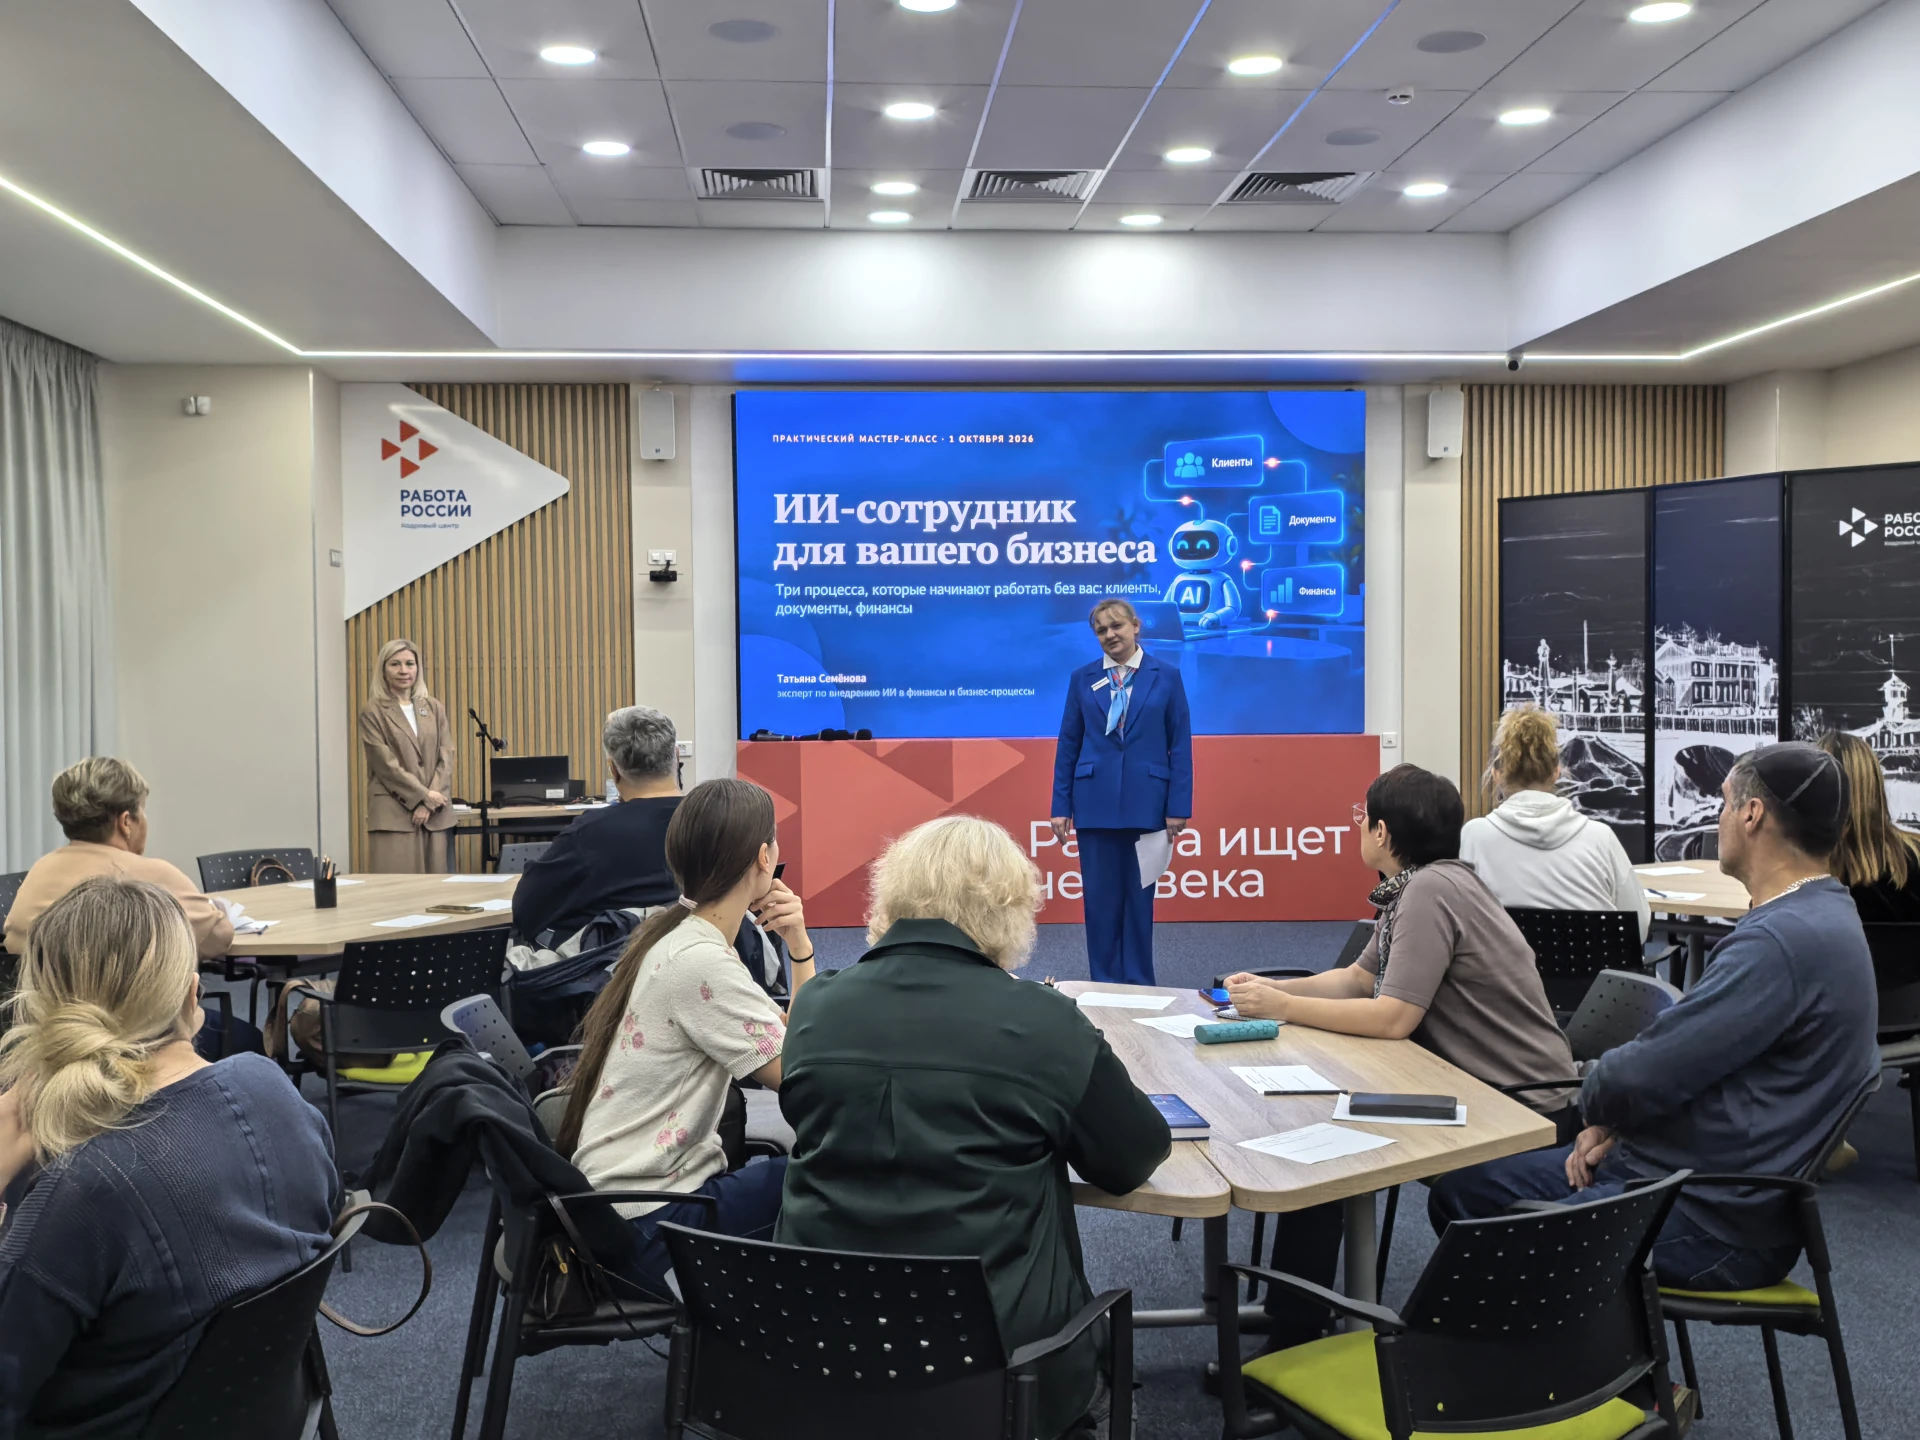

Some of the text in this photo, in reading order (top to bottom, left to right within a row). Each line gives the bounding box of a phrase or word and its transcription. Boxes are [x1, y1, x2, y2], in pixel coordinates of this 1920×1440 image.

[772, 433, 1034, 444] ПРАКТИЧЕСКИЙ МАСТЕР-КЛАСС 1 ОКТЯБРЯ 2026
[1211, 457, 1253, 468] Клиенты
[400, 489, 467, 502] РАБОТА
[400, 504, 472, 517] РОССИИ
[773, 494, 1077, 533] ИИ-сотрудник
[1288, 515, 1337, 527] Документы
[773, 532, 1158, 571] для вашего бизнеса
[775, 582, 1161, 599] Три процесса, которые начинают работать без вас: клиенты,
[1180, 586, 1202, 604] AI
[1298, 586, 1337, 596] Финансы
[775, 602, 913, 617] документы, финансы
[777, 672, 867, 684] Татьяна Семёнова
[777, 686, 1035, 699] эксперт по внедрению ИИ в финансы и бизнес-процессы
[1030, 820, 1350, 861] Раа ищет
[1040, 868, 1265, 900] чевека
